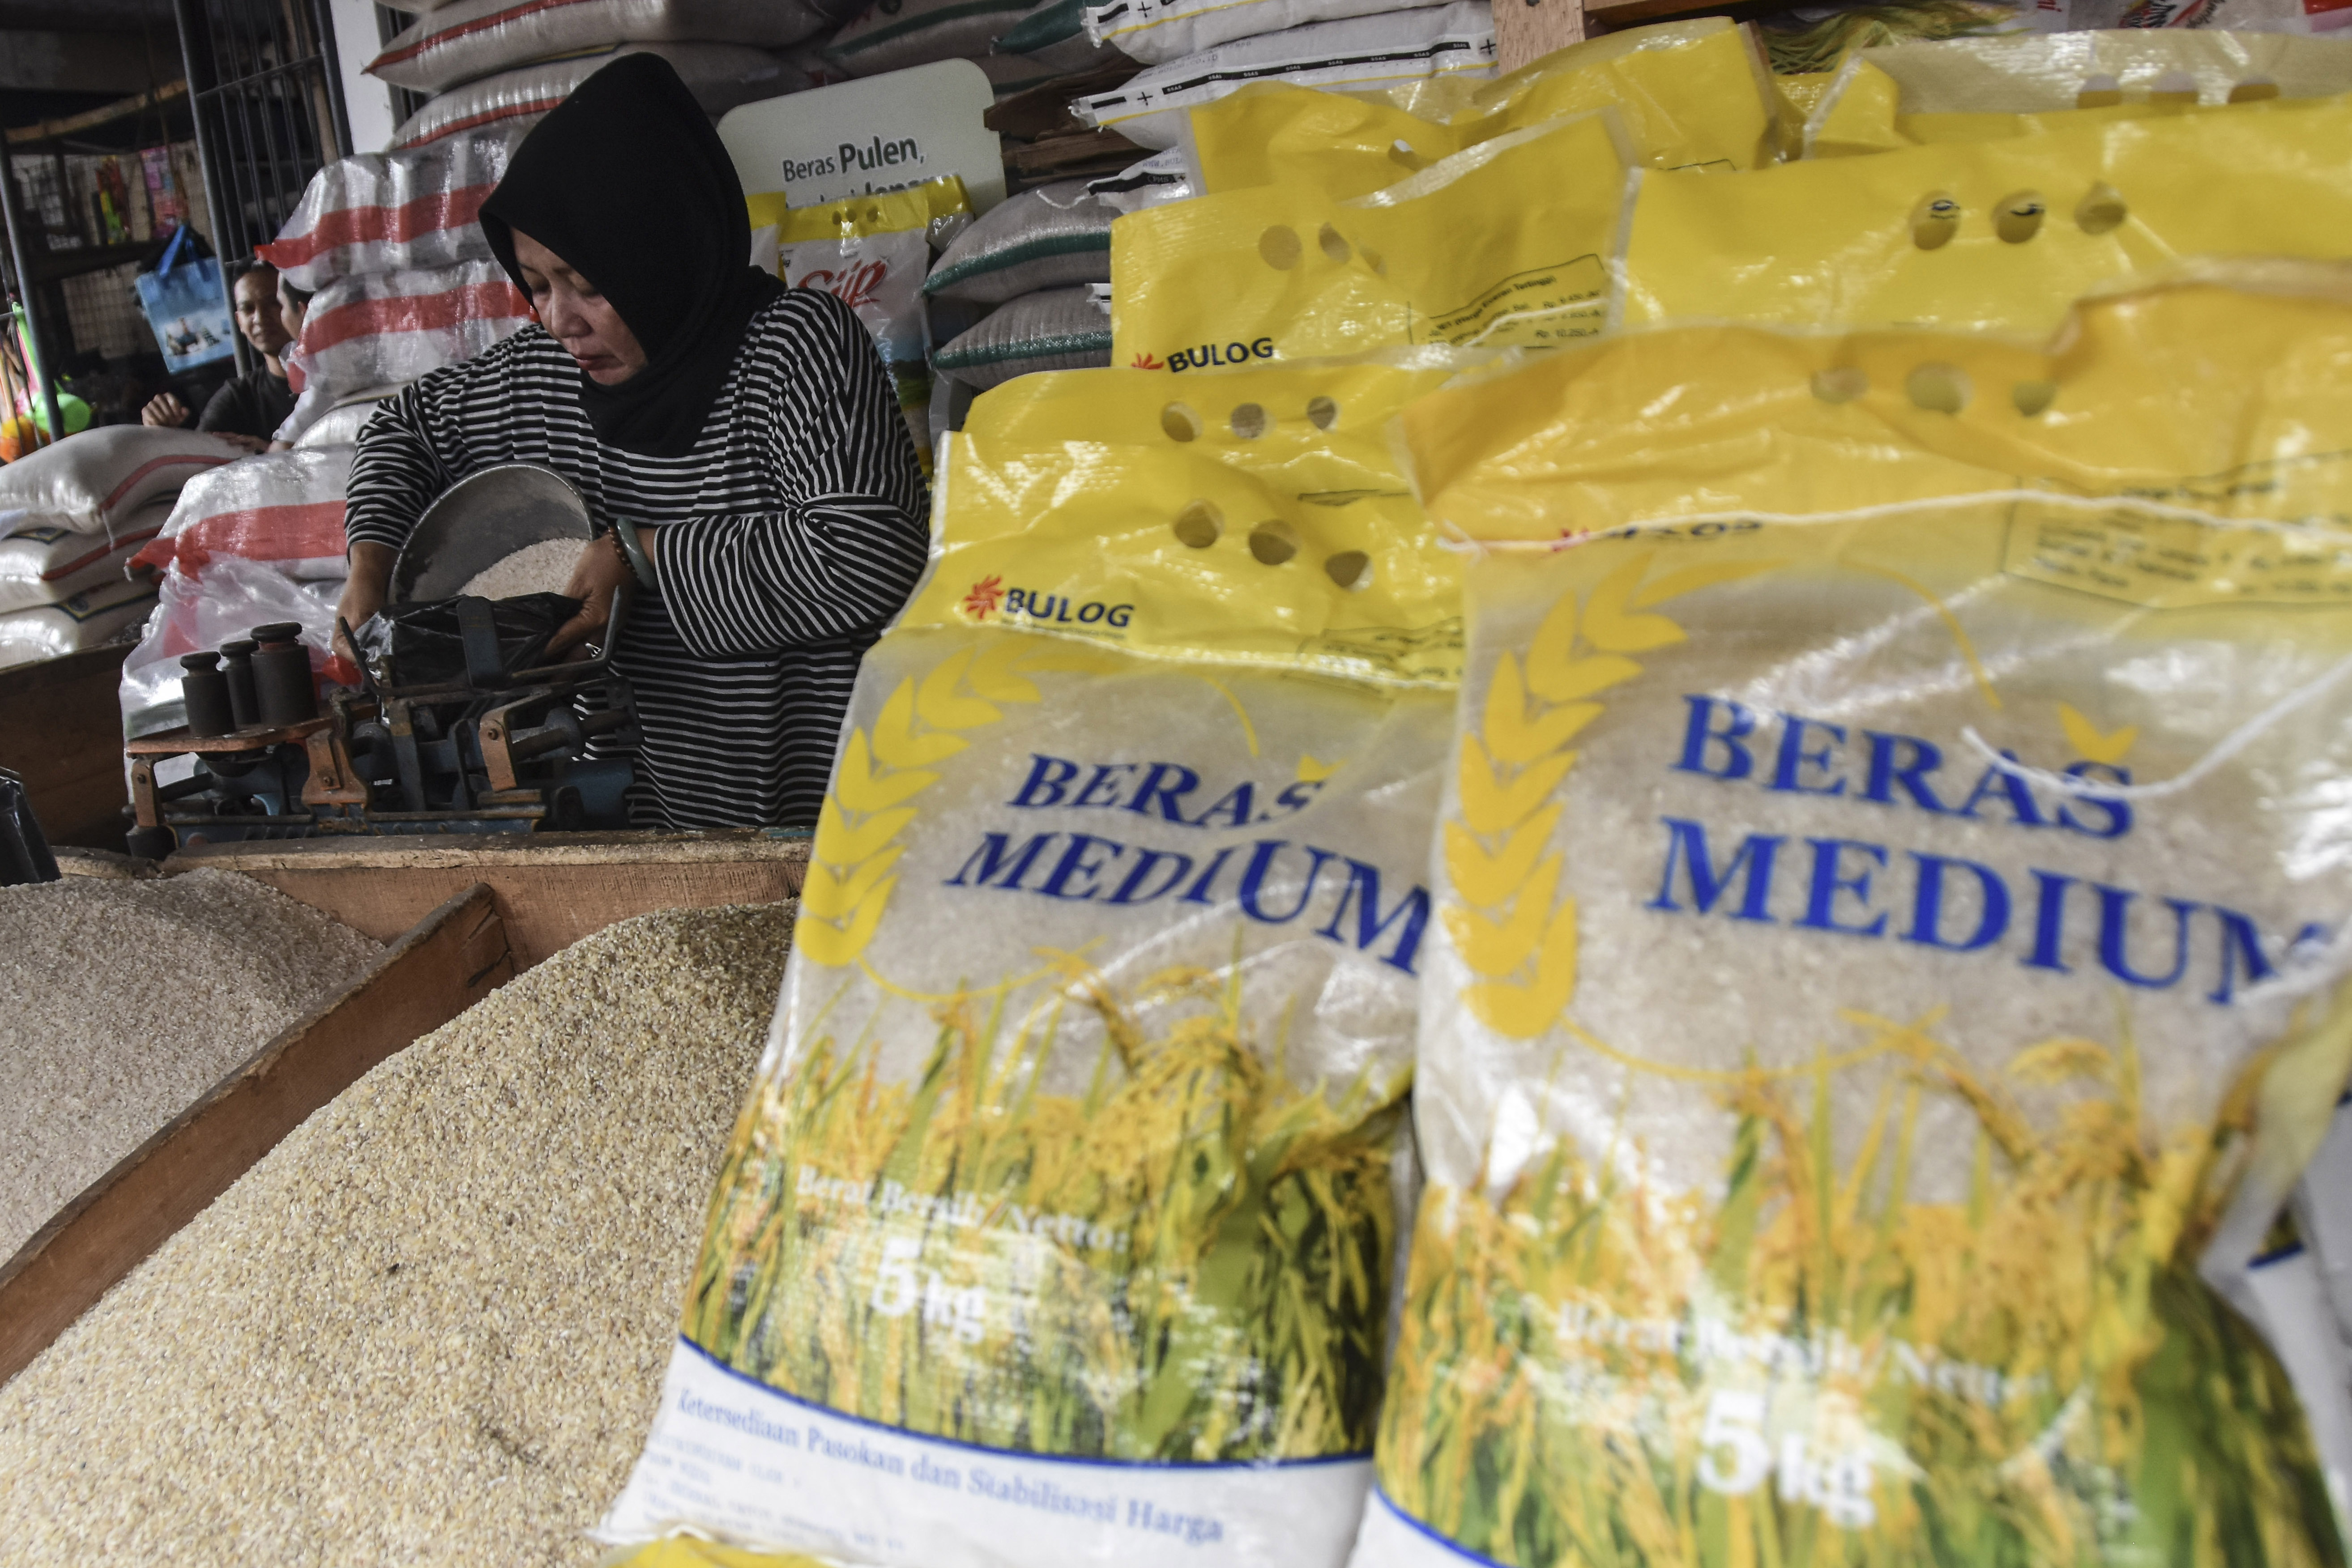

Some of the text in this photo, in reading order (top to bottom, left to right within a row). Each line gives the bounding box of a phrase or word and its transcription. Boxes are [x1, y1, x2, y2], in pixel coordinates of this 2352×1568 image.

[783, 136, 924, 182] Beras Pulen,
[1167, 337, 1274, 373] BULOG
[1006, 587, 1135, 628] BULOG
[1006, 753, 1326, 829] BERAS
[1668, 692, 2134, 841] BERAS
[940, 831, 1430, 979] MEDIUM
[807, 1425, 905, 1477] Pasokan
[910, 1454, 961, 1491] dan
[967, 1465, 1117, 1523] Stabilisasi
[1127, 1498, 1225, 1547] Harga
[1699, 1389, 1769, 1494] 5
